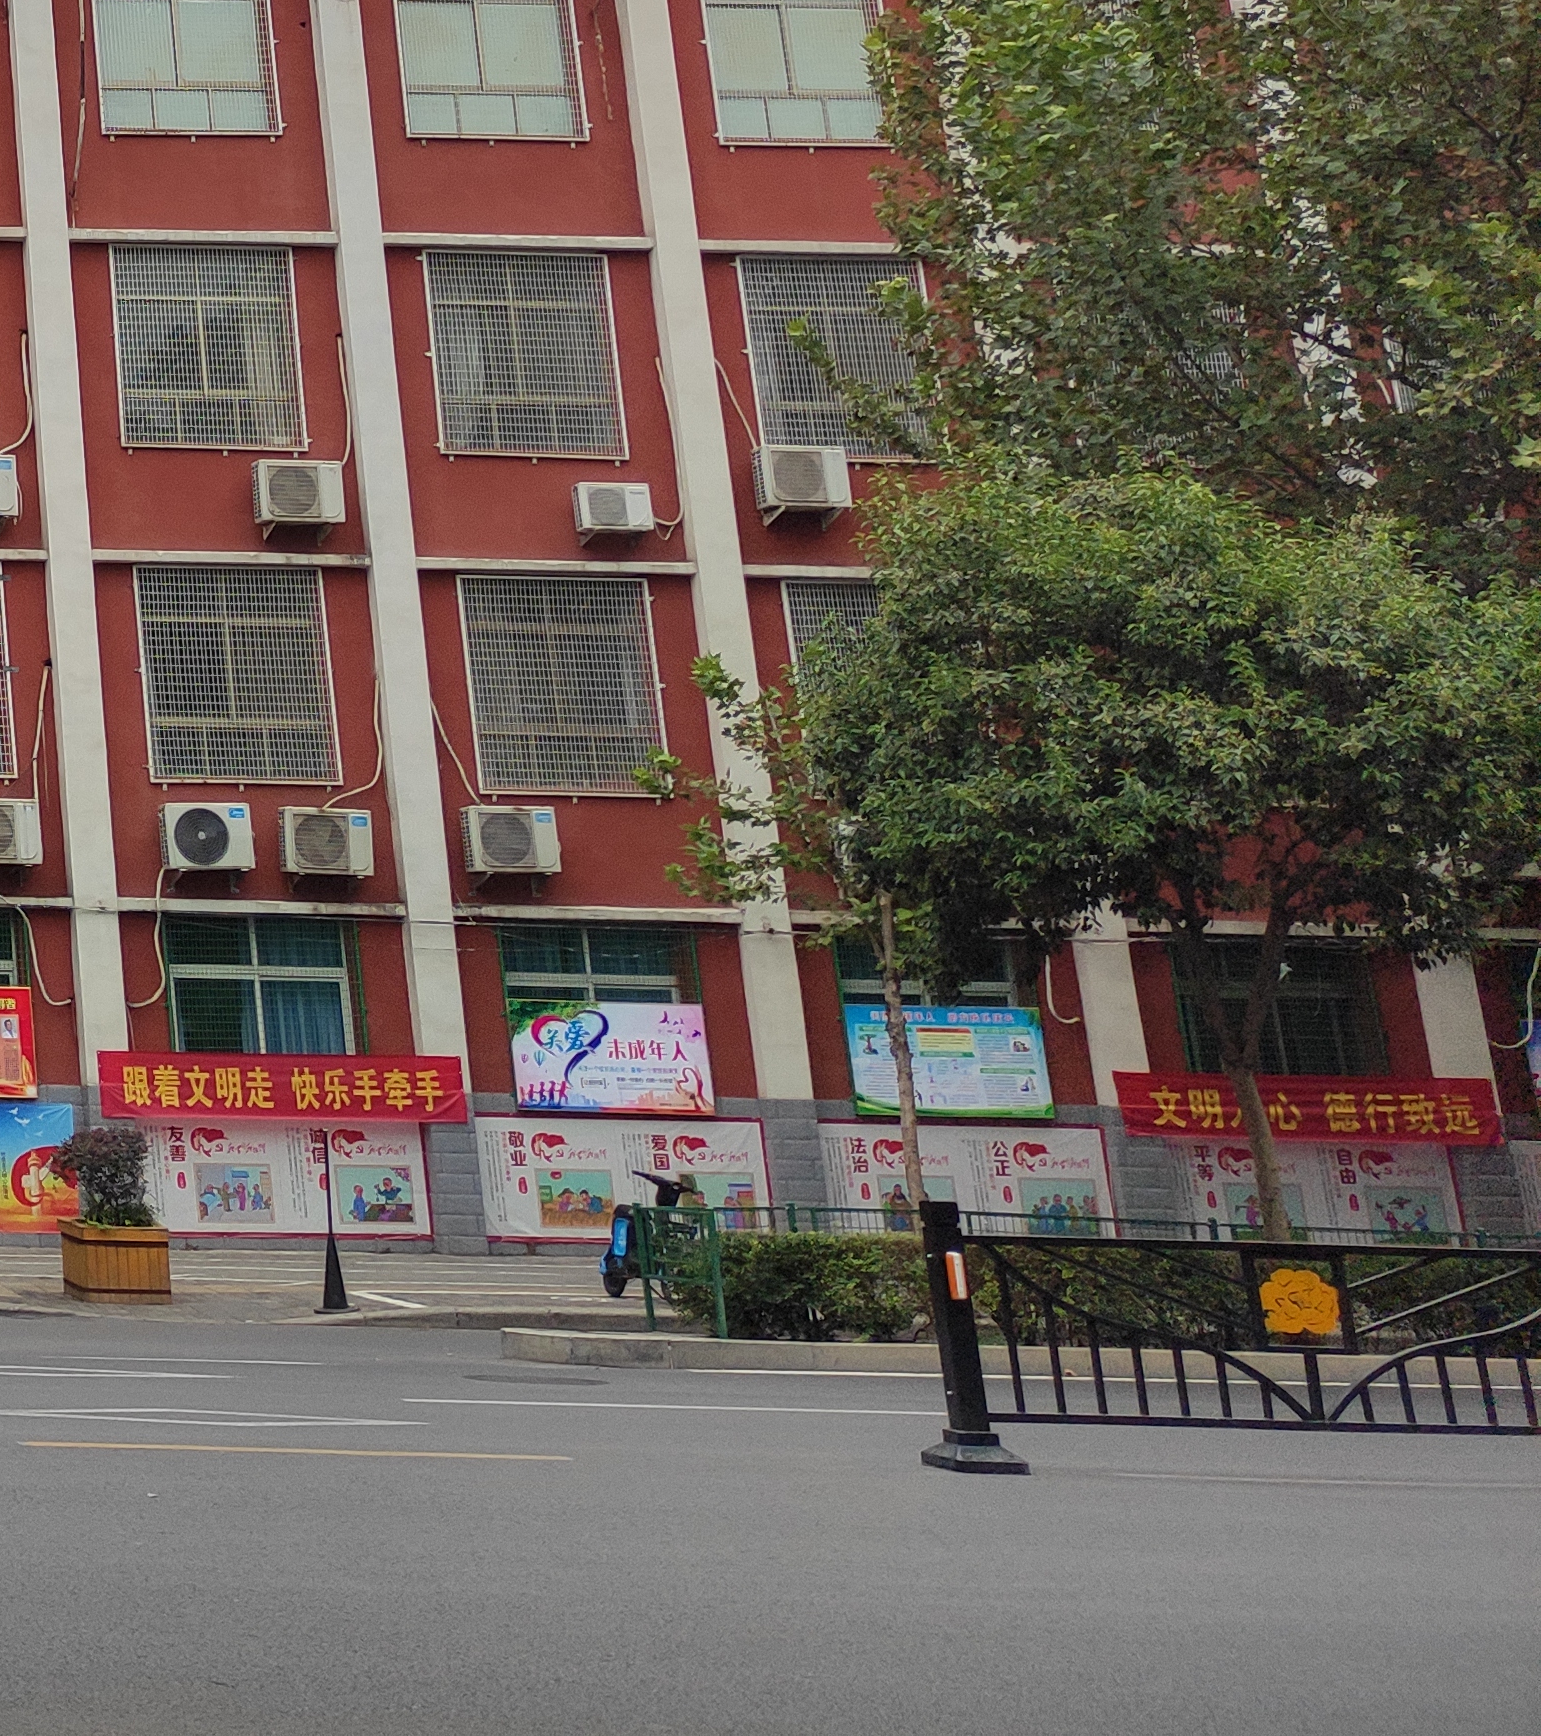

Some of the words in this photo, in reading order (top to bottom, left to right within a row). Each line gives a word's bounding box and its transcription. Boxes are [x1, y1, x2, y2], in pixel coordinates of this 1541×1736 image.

[542, 1019, 590, 1053] 关爱
[607, 1038, 689, 1062] 未成年人
[122, 1064, 276, 1109] 跟着文明走
[291, 1067, 445, 1112] 快乐手牵手
[1323, 1091, 1481, 1135] 德行致远
[168, 1126, 187, 1162] 友善
[508, 1131, 528, 1166] 敬业
[650, 1134, 670, 1170] 爱国
[850, 1137, 869, 1173] 法治
[992, 1140, 1012, 1177] 公正
[1336, 1148, 1357, 1185] 自由
